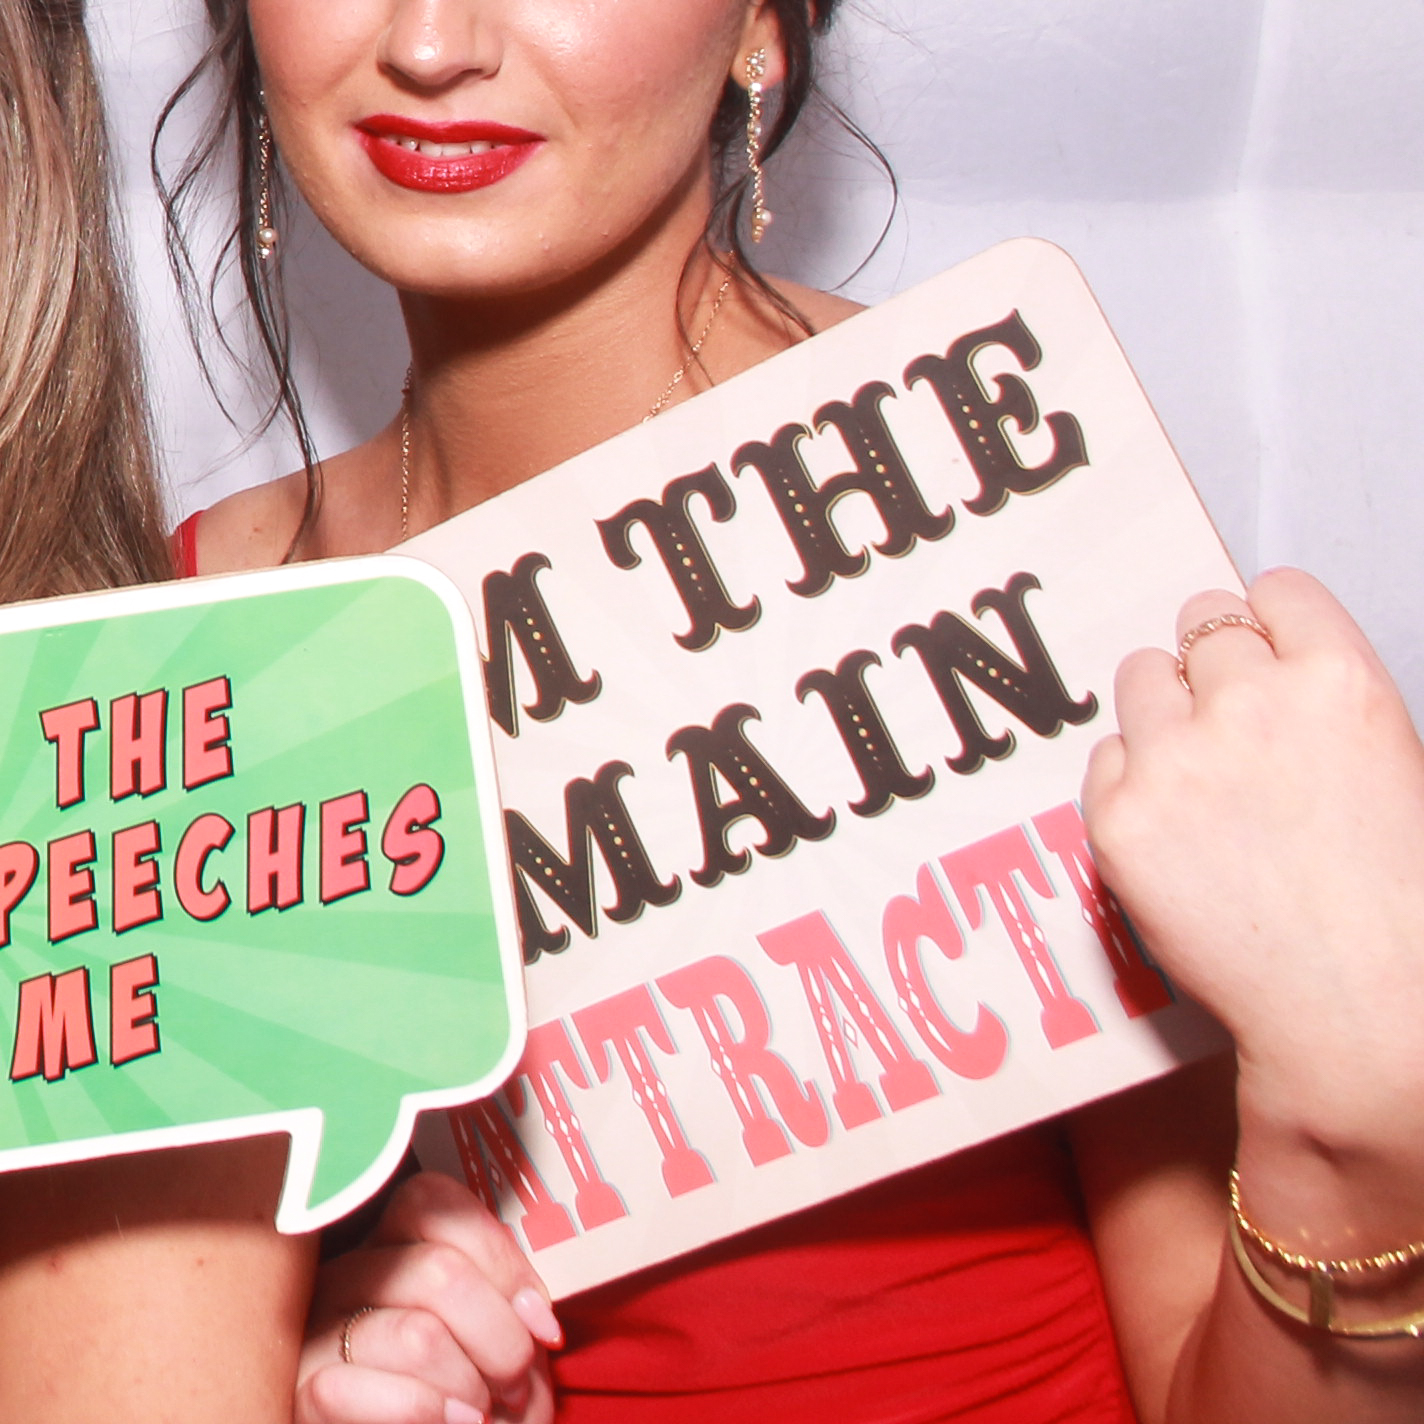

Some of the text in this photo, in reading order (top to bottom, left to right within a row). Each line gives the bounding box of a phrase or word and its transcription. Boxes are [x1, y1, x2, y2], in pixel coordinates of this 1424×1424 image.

[593, 308, 1090, 652] THE
[39, 675, 234, 809] THE
[502, 571, 1099, 965] MAIN
[9, 953, 162, 1084] ME
[447, 798, 1176, 1253] ATTRACTI
